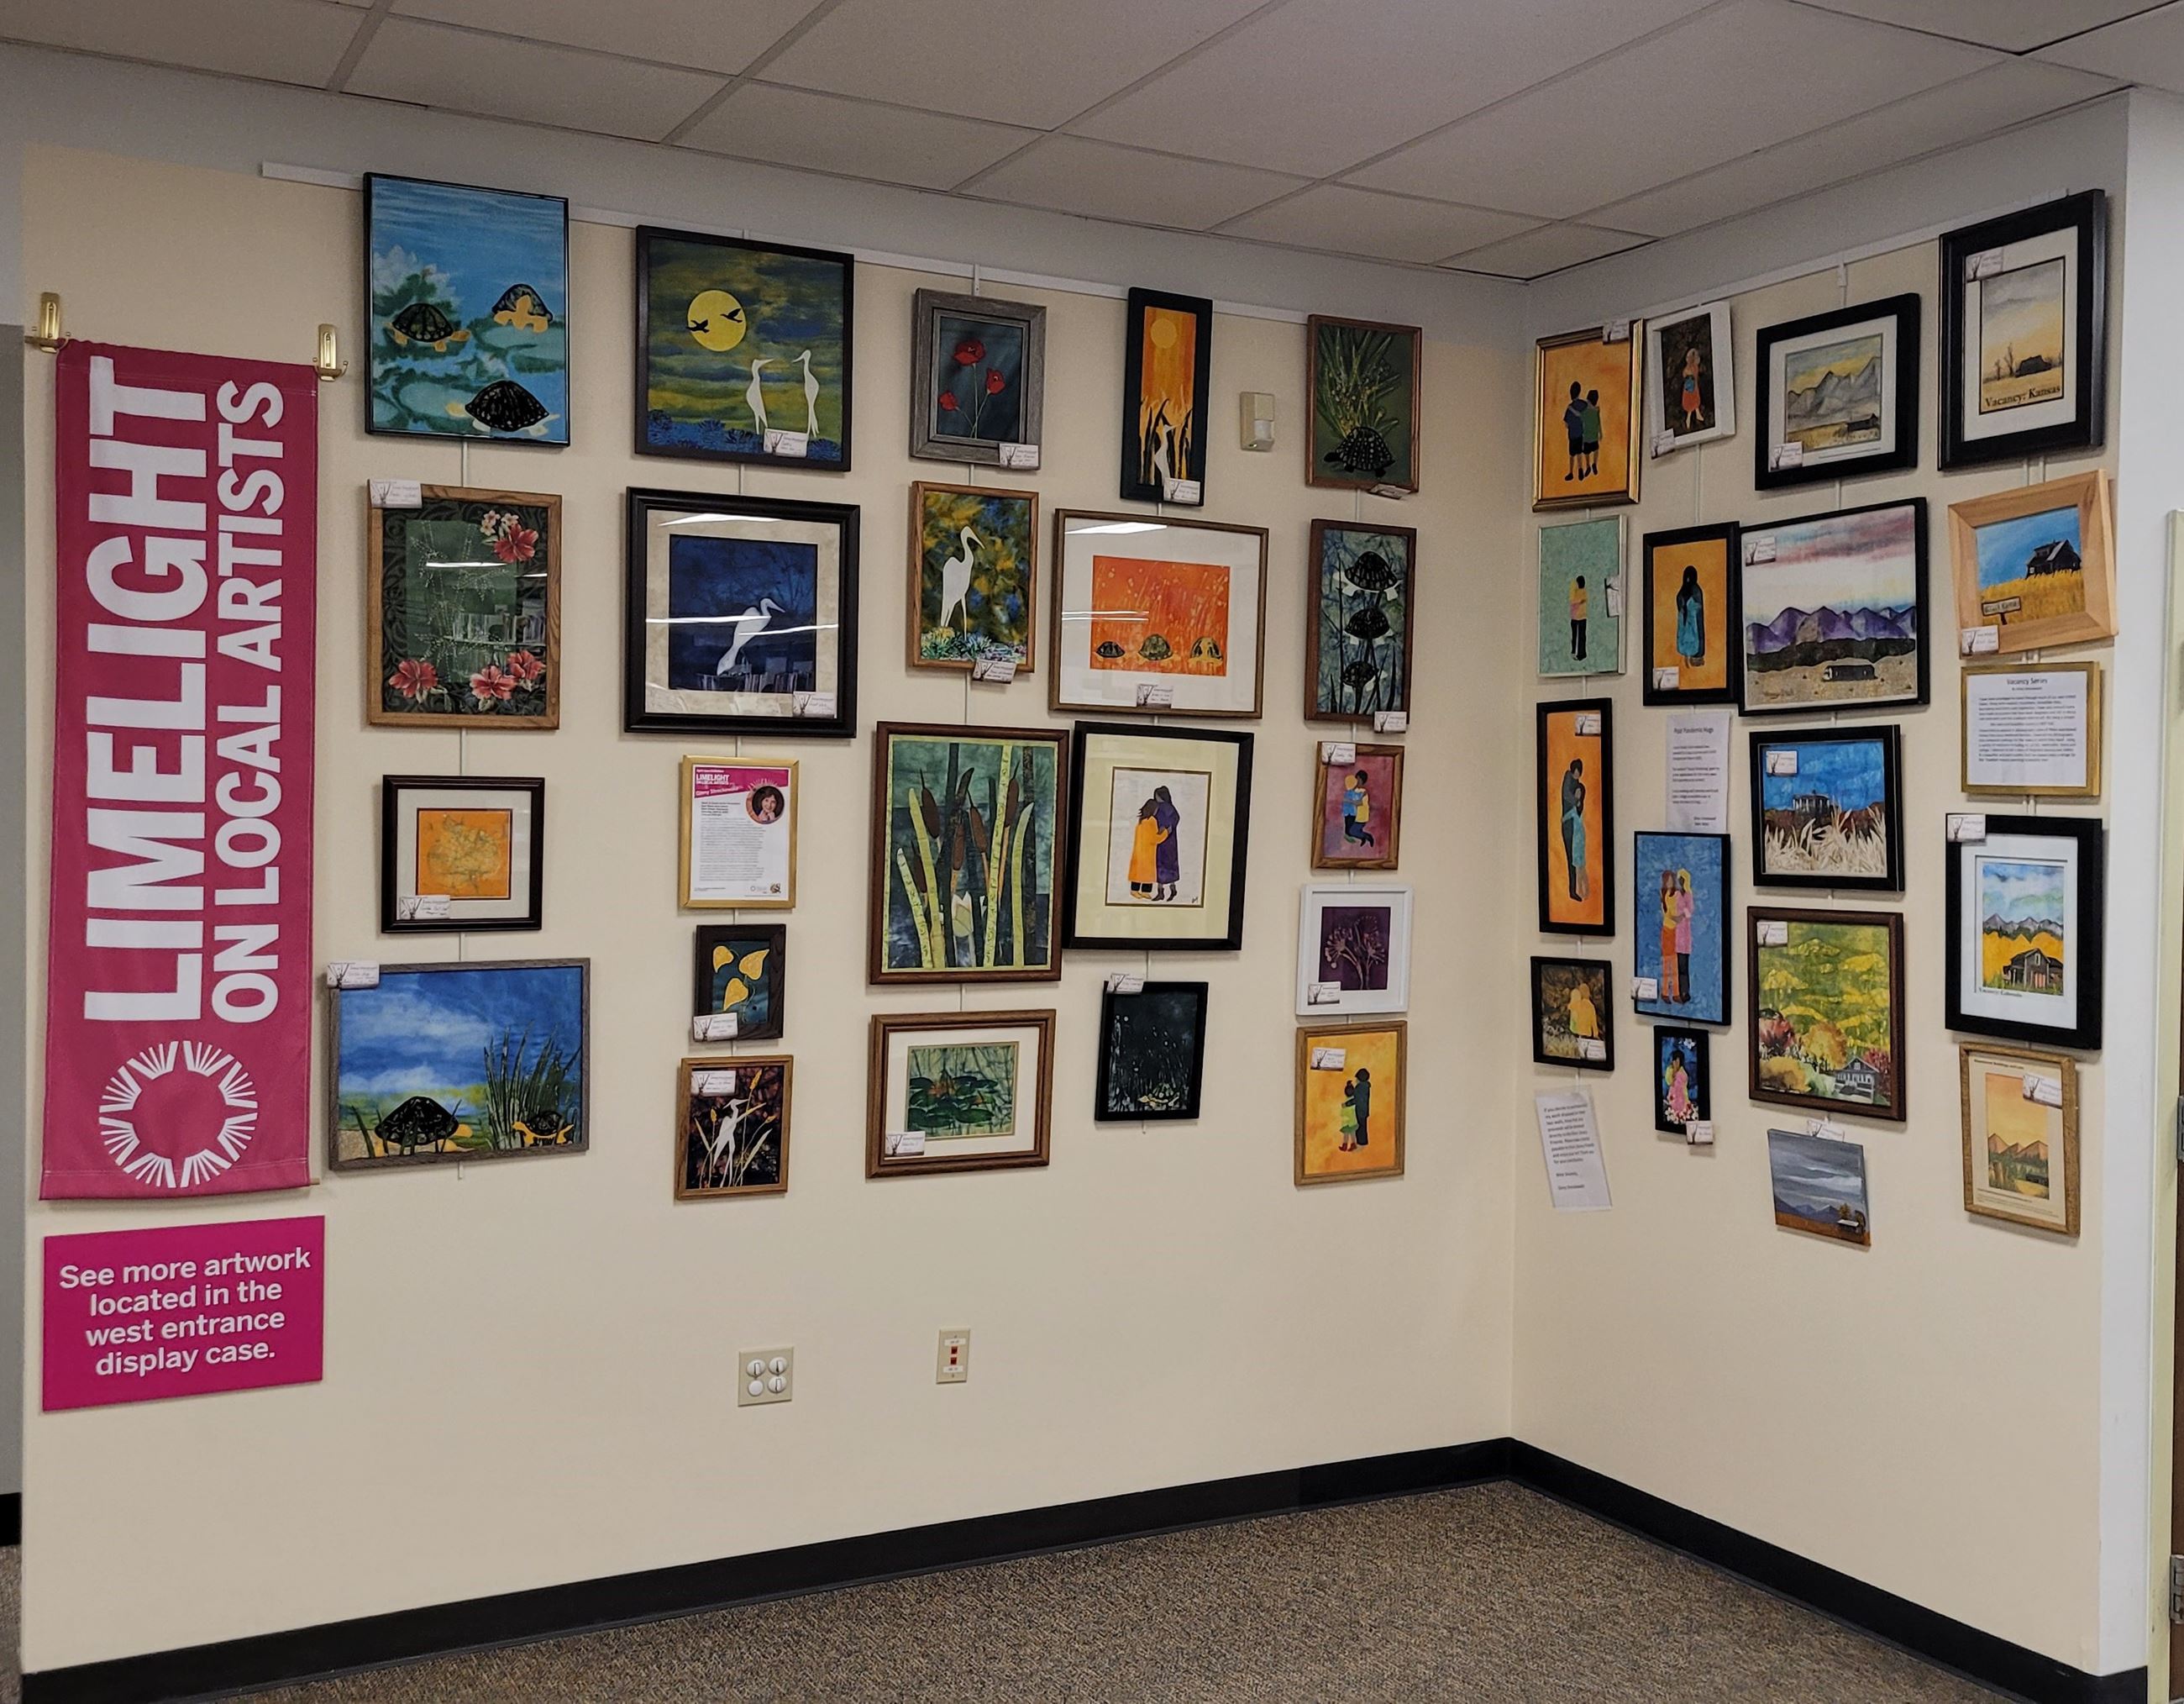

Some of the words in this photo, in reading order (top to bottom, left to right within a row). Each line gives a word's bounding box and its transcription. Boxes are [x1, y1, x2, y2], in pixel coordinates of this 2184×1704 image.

[2029, 386, 2061, 399] Kansas
[216, 380, 285, 673] ARTISTS
[84, 355, 208, 1022] LIMELIGHT
[214, 685, 282, 906] LOCAL
[696, 773, 730, 782] LIMELIGHT
[212, 924, 280, 1023] ON
[59, 1264, 115, 1289] See
[122, 1260, 197, 1285] more
[203, 1247, 312, 1277] artwork
[89, 1285, 197, 1317] located
[204, 1284, 229, 1306] in
[236, 1281, 283, 1304] the
[85, 1321, 155, 1347] west
[160, 1310, 286, 1340] entrance
[95, 1346, 199, 1377] display
[204, 1340, 276, 1365] case.
